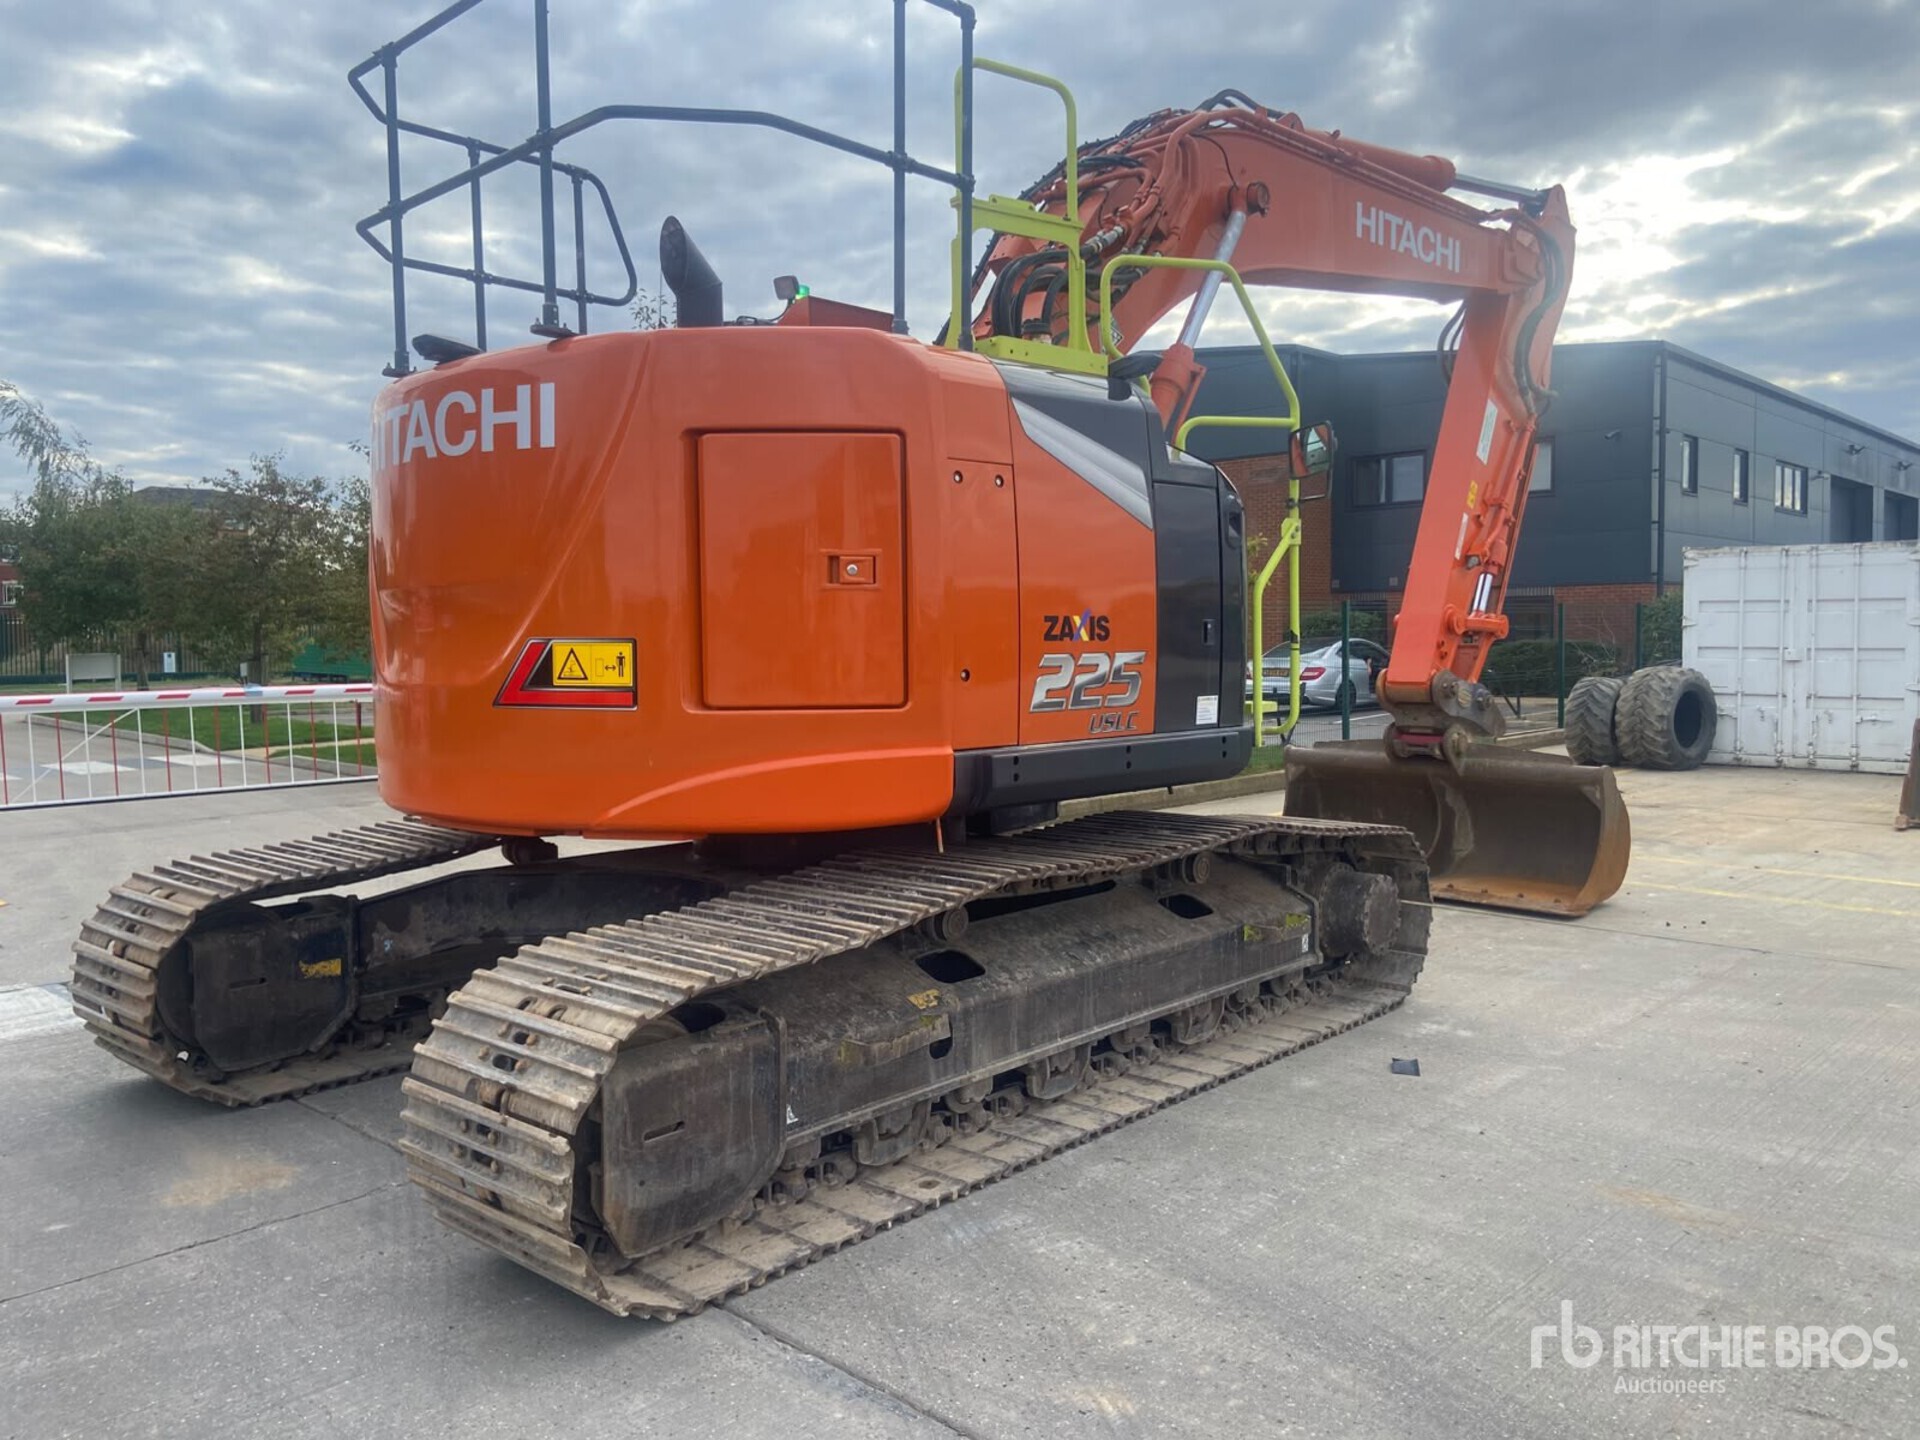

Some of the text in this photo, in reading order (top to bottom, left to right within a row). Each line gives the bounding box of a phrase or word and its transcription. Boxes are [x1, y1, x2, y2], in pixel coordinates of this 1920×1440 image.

[1356, 201, 1461, 274] HITACHI
[1043, 608, 1111, 642] ZAXIS
[1029, 650, 1147, 713] 225
[1089, 711, 1140, 734] USLC
